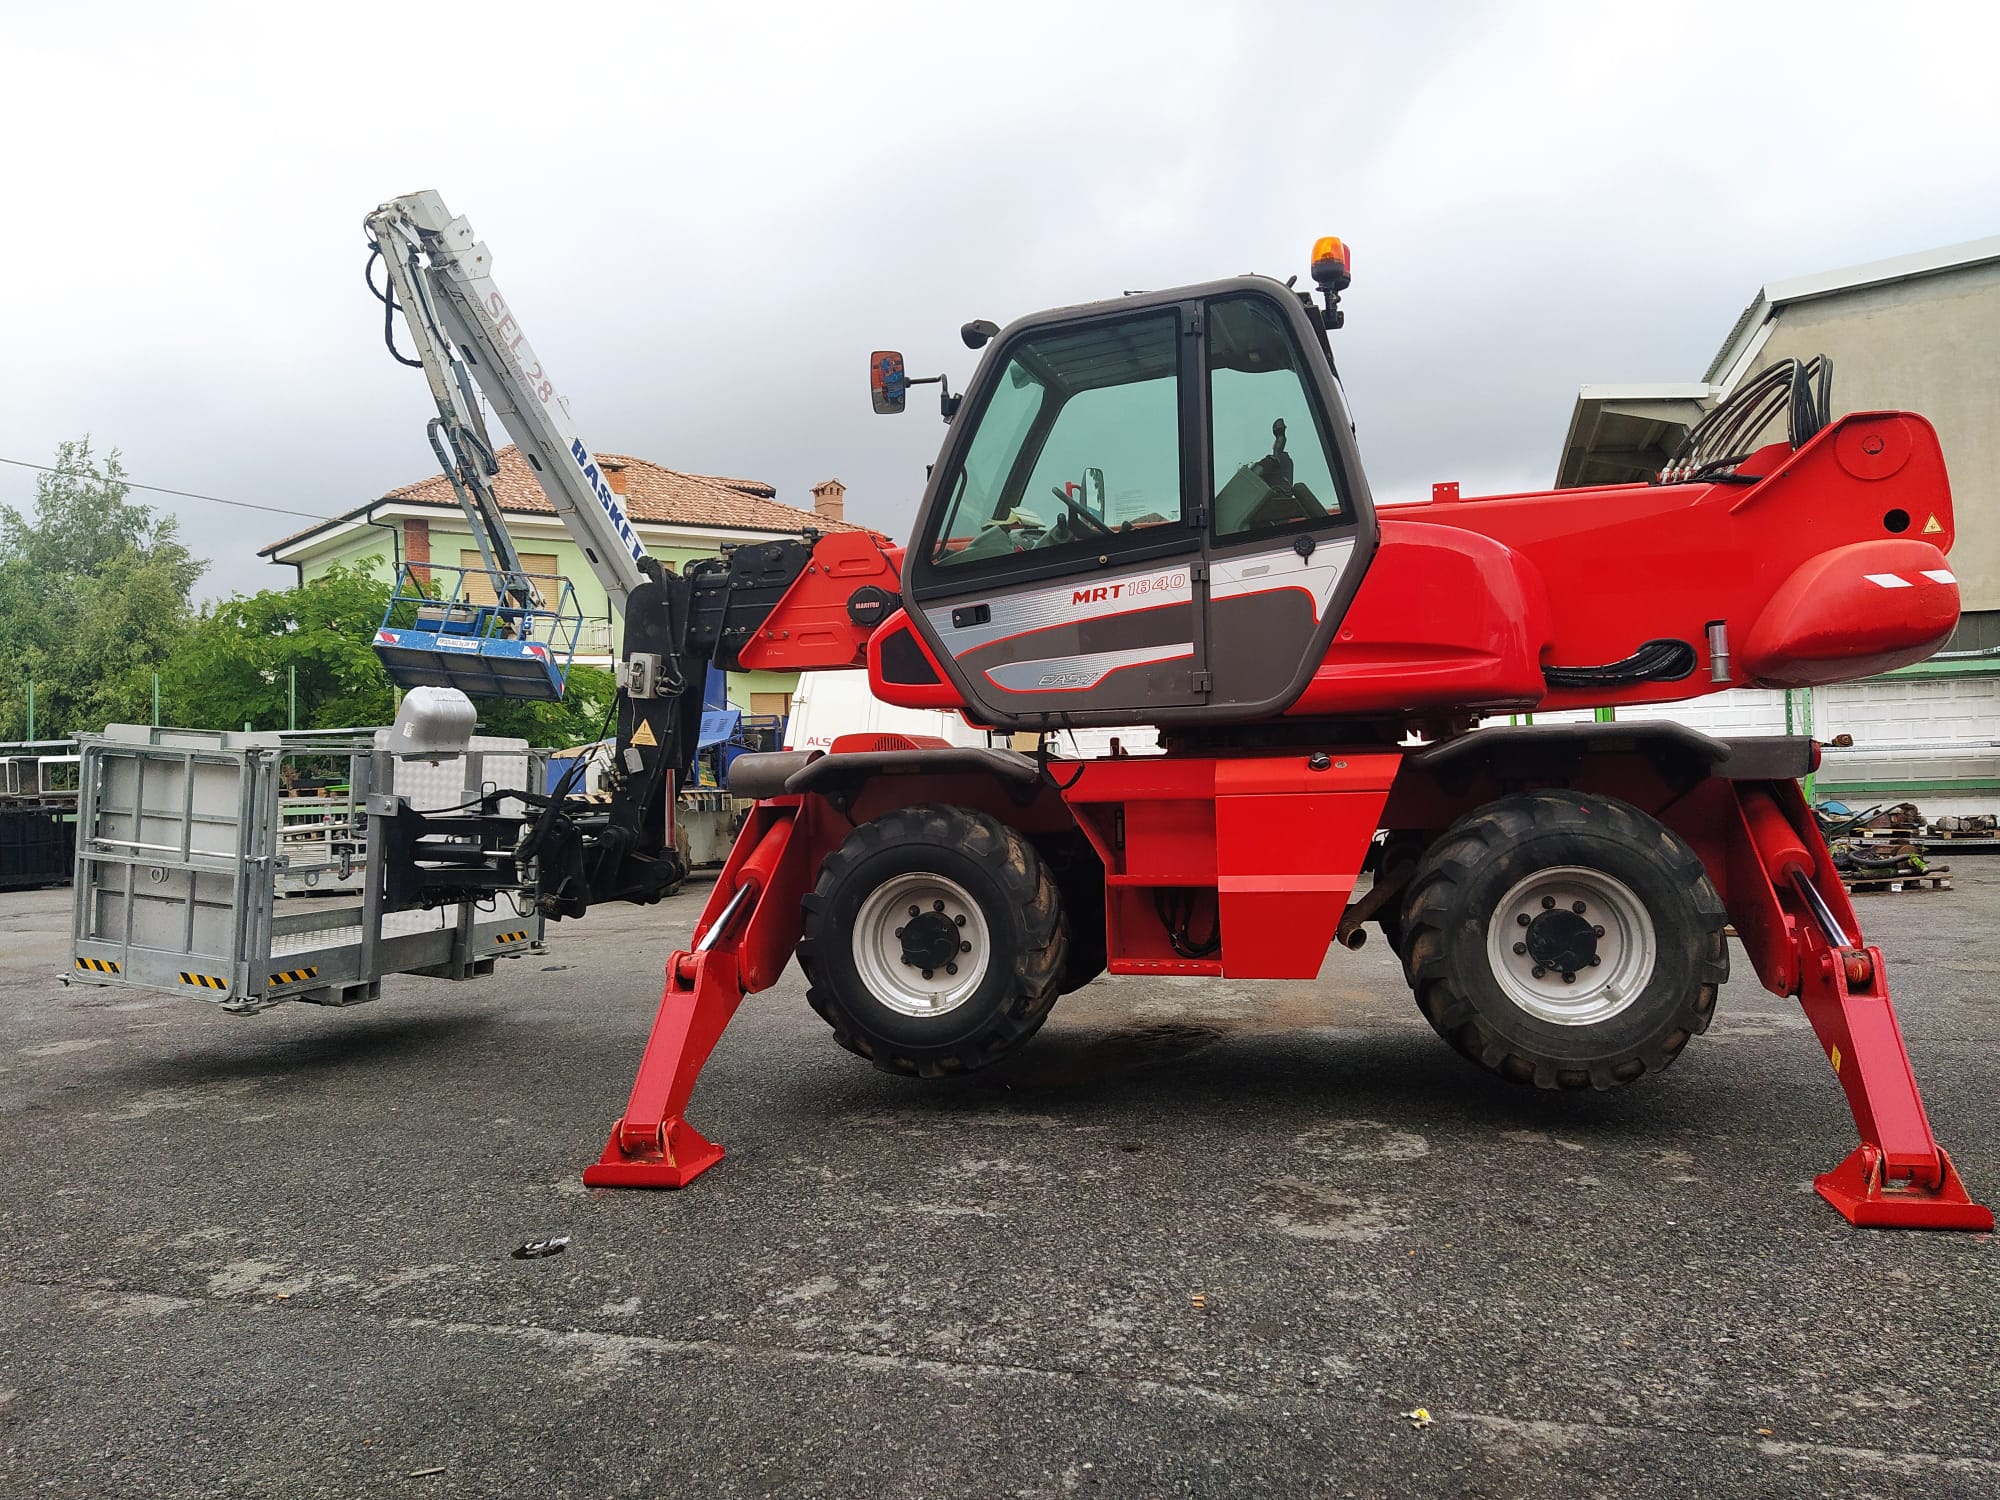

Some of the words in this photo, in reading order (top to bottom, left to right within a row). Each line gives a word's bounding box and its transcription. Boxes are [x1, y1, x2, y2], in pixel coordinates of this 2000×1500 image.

[485, 292, 524, 361] SEL
[526, 362, 553, 403] 28
[571, 437, 644, 561] BASKET
[855, 601, 880, 609] MANITOU
[1072, 584, 1125, 605] MRT
[1128, 574, 1186, 596] 1840
